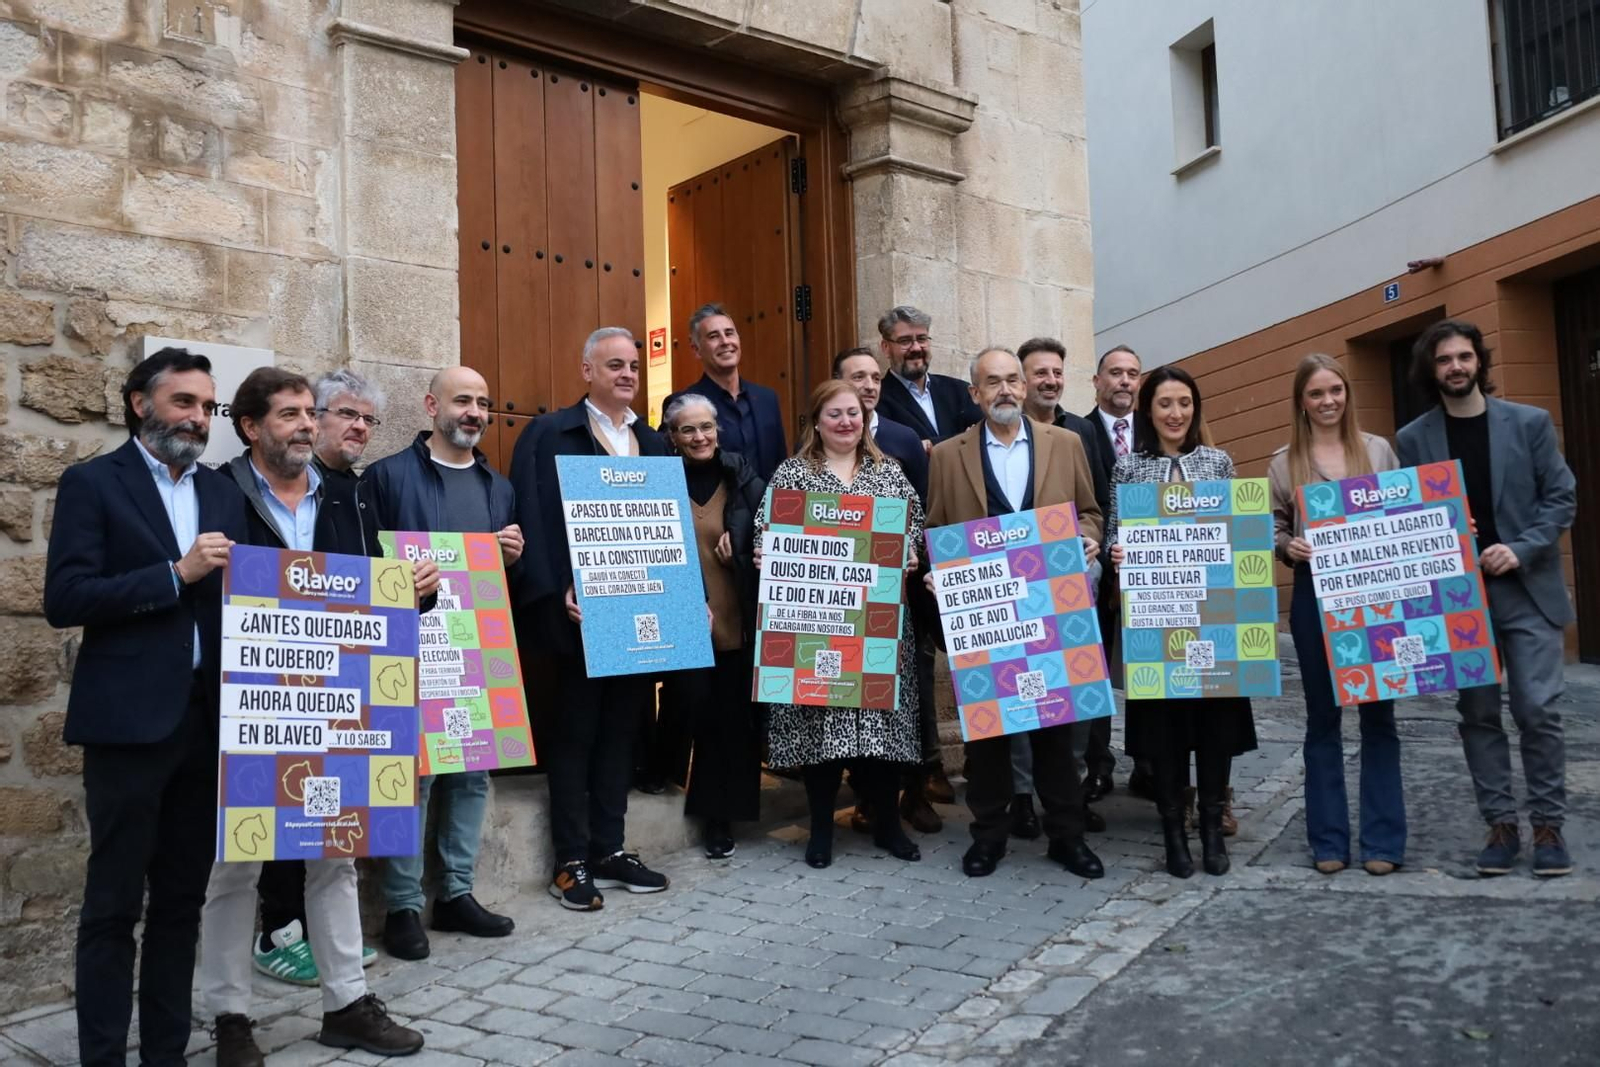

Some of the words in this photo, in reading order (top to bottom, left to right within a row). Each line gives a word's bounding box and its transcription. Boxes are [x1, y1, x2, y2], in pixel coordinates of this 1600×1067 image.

[1388, 286, 1395, 299] 5
[571, 503, 608, 518] ¿PASEO
[611, 503, 623, 517] DE
[625, 503, 660, 517] GRACIA
[662, 502, 675, 516] DE
[574, 527, 633, 542] BARCELONA
[634, 526, 641, 541] O
[644, 526, 674, 540] PLAZA
[1126, 527, 1182, 544] ¿CENTRAL
[1186, 527, 1221, 542] PARK?
[1312, 527, 1371, 548] ¡MENTIRA!
[1375, 523, 1389, 537] EL
[1390, 512, 1444, 534] LAGARTO
[578, 551, 591, 566] DE
[593, 550, 606, 566] LA
[609, 546, 682, 565] CONSTITUCIÓN?
[772, 536, 780, 552] A
[783, 538, 819, 555] QUIEN
[822, 540, 849, 557] DIOS
[1127, 550, 1163, 565] MEJOR
[1167, 549, 1179, 563] EL
[1183, 548, 1225, 563] PARQUE
[1316, 554, 1331, 570] DE
[1333, 552, 1348, 567] LA
[1351, 545, 1399, 564] MALENA
[1402, 533, 1454, 554] REVENTÓ
[609, 571, 617, 581] YA
[770, 561, 805, 578] QUISO
[809, 564, 839, 582] BIEN,
[842, 566, 872, 583] CASA
[942, 569, 976, 588] ¿ERES
[978, 563, 1003, 583] MÁS
[1128, 572, 1148, 586] DEL
[1152, 570, 1201, 585] BULEVAR
[1320, 576, 1343, 592] POR
[1346, 566, 1400, 588] EMPACHO
[1404, 563, 1419, 578] DE
[1422, 557, 1456, 576] GIGAS
[585, 585, 598, 595] CON
[600, 584, 607, 594] EL
[608, 583, 636, 594] CORAZÓN
[638, 583, 645, 593] DE
[769, 585, 783, 601] LE
[786, 587, 805, 603] DIO
[809, 589, 825, 604] EN
[827, 588, 856, 606] JAÉN
[945, 593, 959, 608] DE
[962, 587, 992, 604] GRAN
[995, 581, 1019, 599] EJE?
[1152, 591, 1174, 600] GUSTA
[1176, 590, 1203, 599] PENSAR
[1346, 595, 1367, 606] PUSO
[1368, 591, 1391, 603] COMO
[1392, 589, 1401, 599] EL
[1403, 585, 1428, 598] QUICO
[787, 609, 795, 618] LA
[797, 610, 817, 619] FIBRA
[819, 611, 827, 620] YA
[828, 612, 843, 621] NOS
[1131, 605, 1136, 614] A
[1138, 605, 1146, 613] LO
[1179, 603, 1193, 612] NOS
[241, 612, 300, 636] ¿ANTES
[304, 616, 382, 641] QUEDABAS
[769, 621, 815, 633] ENCARGAMOS
[816, 624, 852, 635] NOSOTROS
[950, 613, 964, 631] ¿O
[969, 612, 984, 626] DE
[987, 608, 1008, 624] AVD
[1132, 618, 1153, 627] GUSTA
[1155, 618, 1164, 626] LO
[1165, 617, 1197, 626] NUESTRO
[438, 632, 449, 645] ES
[953, 636, 967, 651] DE
[971, 623, 1038, 649] ANDALUCÍA?
[240, 646, 260, 667] EN
[265, 647, 334, 670] CUBERO?
[422, 648, 460, 662] ELECCIÓN
[239, 689, 292, 712] AHORA
[296, 692, 356, 714] QUEDAS
[238, 723, 259, 745] EN
[264, 725, 322, 746] BLAVEO
[344, 733, 356, 746] LO
[357, 733, 387, 747] SABES
